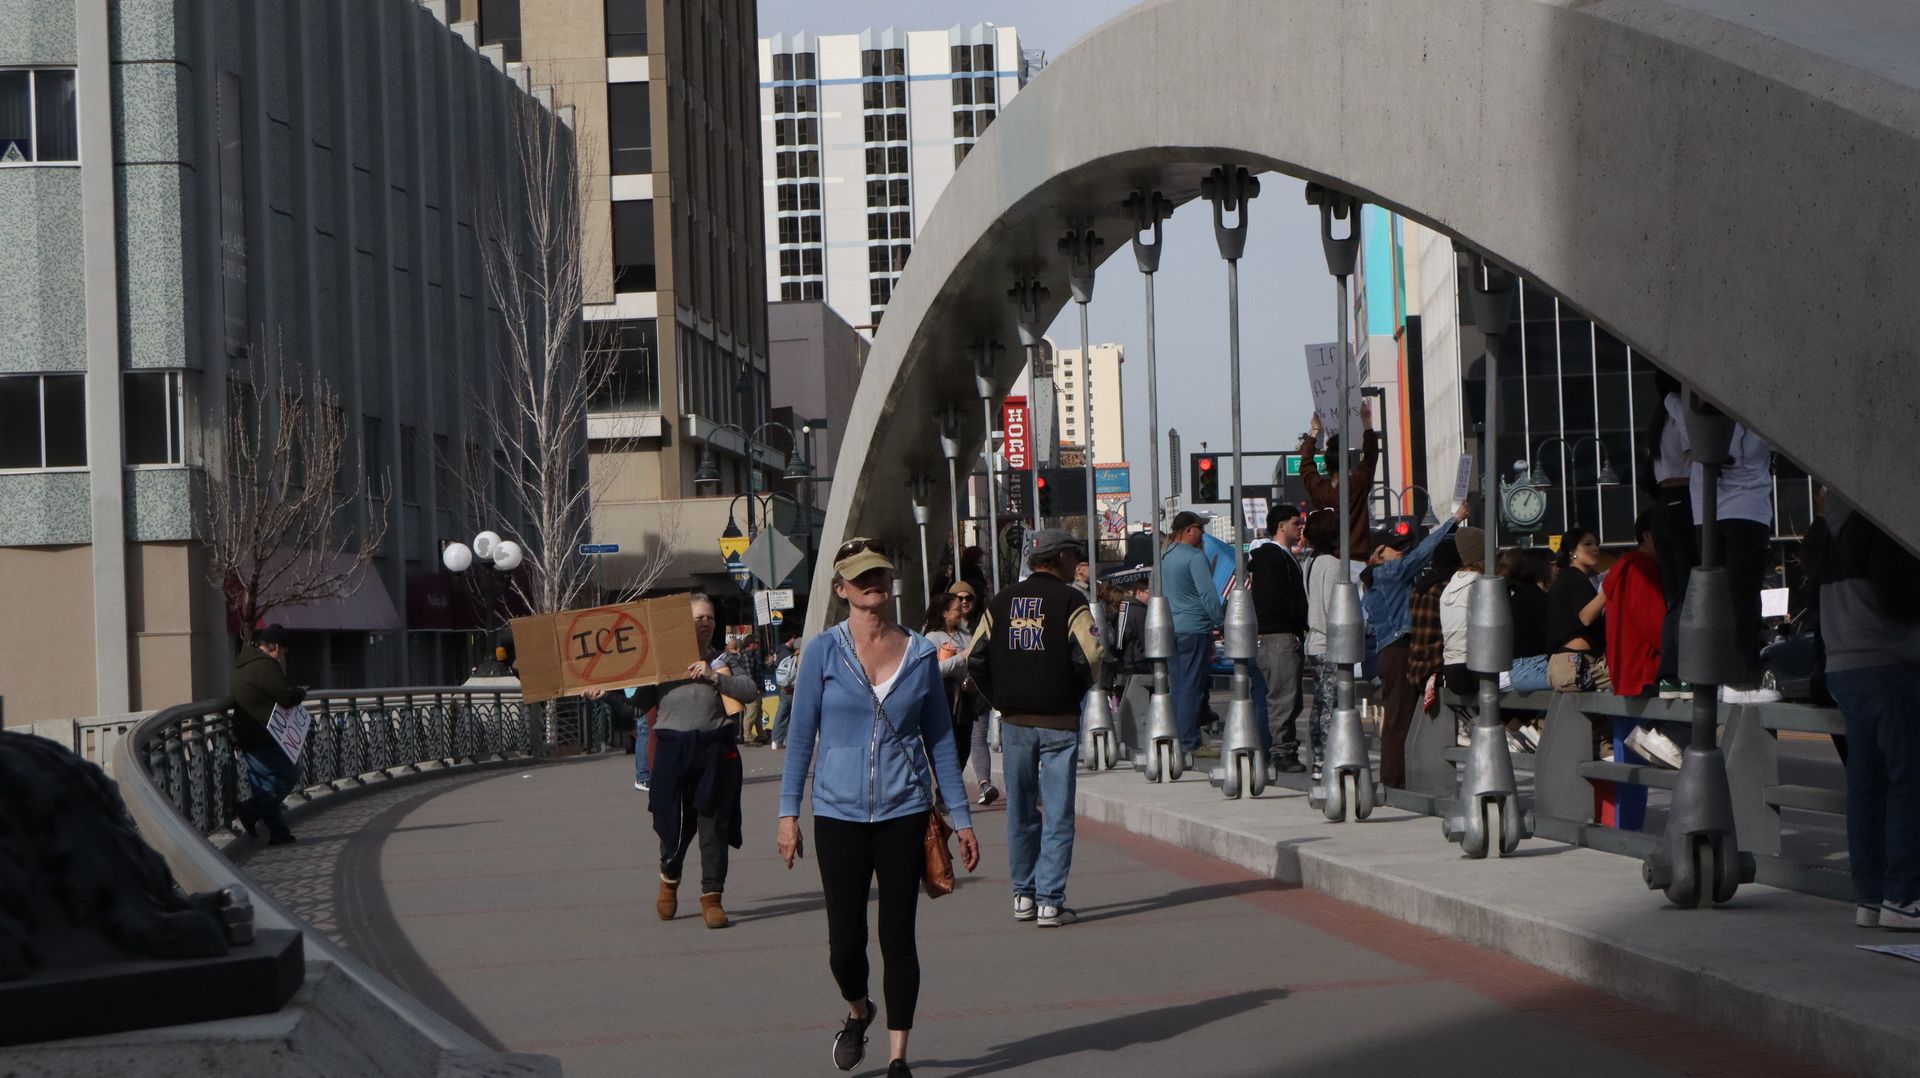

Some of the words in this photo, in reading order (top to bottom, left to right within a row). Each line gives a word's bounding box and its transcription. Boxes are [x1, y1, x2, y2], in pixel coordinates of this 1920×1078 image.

[1009, 597, 1045, 620] NFL
[1010, 618, 1043, 628] ON
[572, 626, 637, 660] ICE
[1008, 627, 1045, 651] FOX
